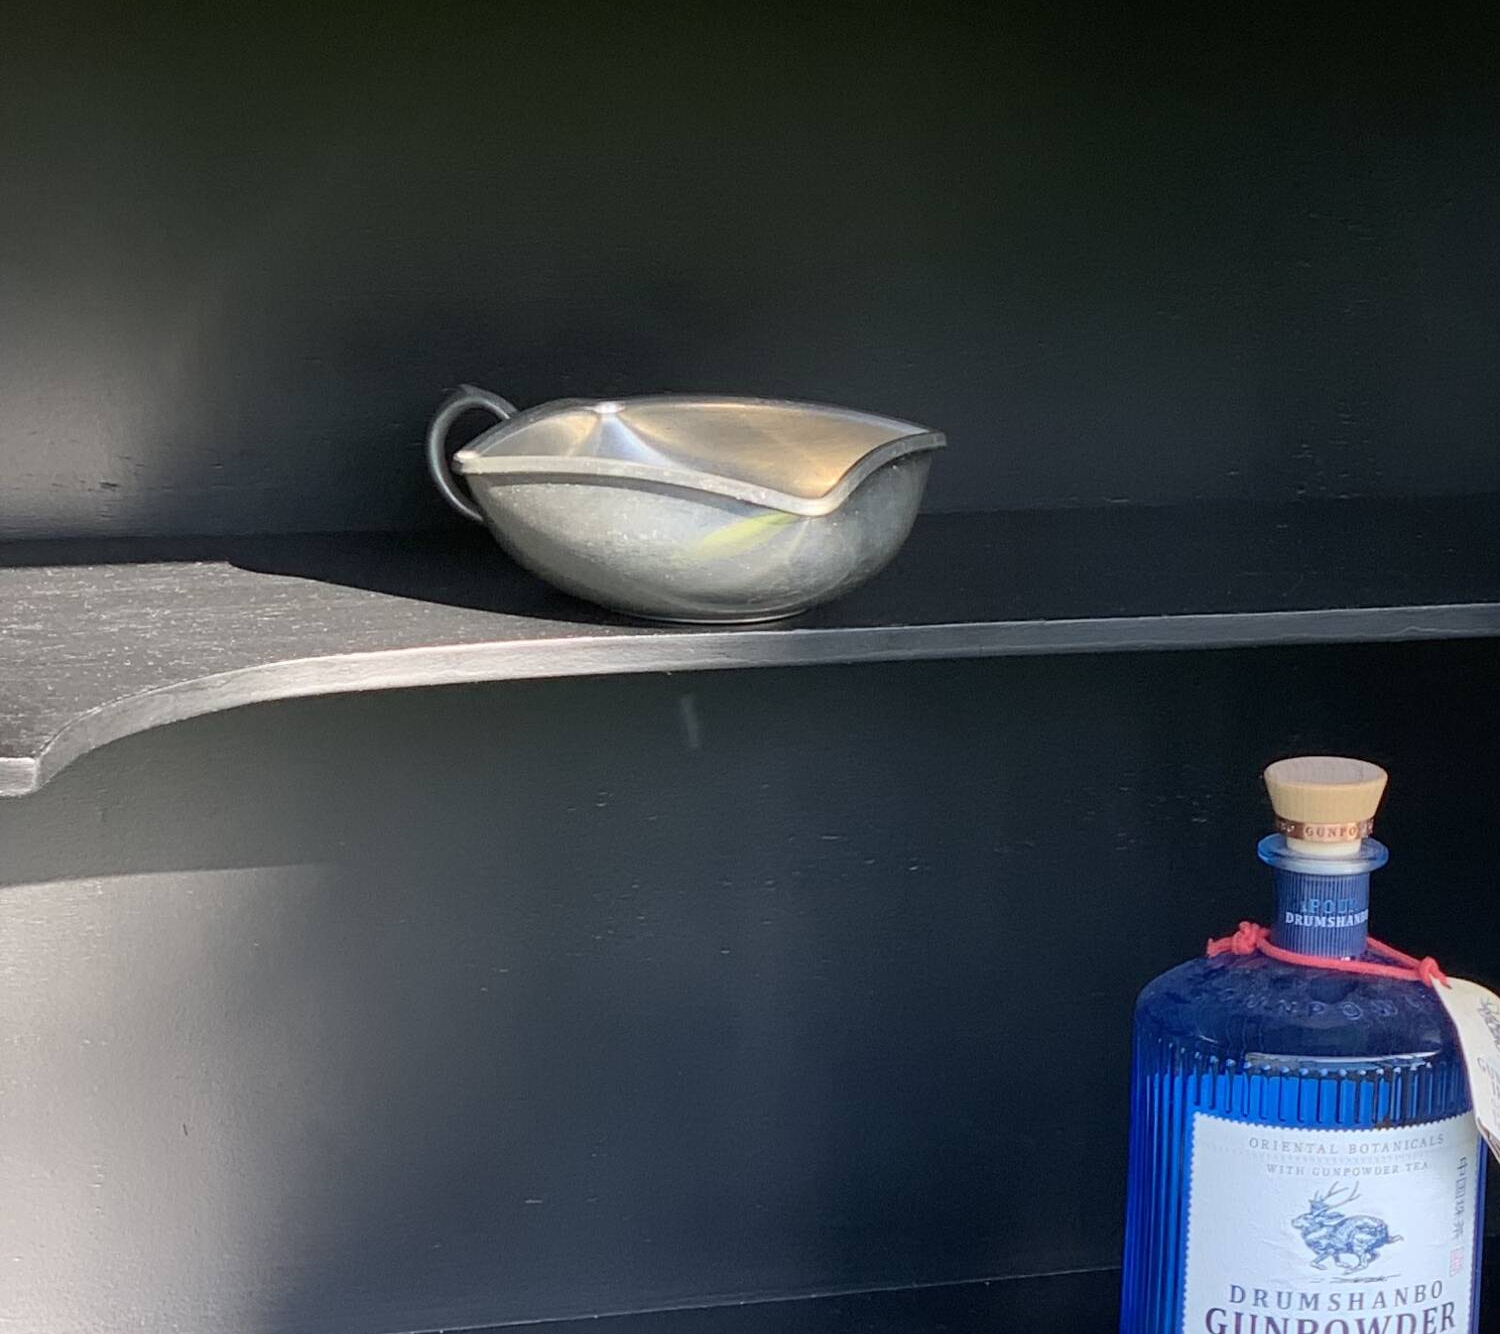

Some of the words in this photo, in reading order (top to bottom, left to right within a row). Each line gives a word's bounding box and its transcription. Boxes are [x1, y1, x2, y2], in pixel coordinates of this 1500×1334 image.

[1249, 1137, 1338, 1154] ORIENTAL
[1349, 1134, 1444, 1154] BOTANICALS
[1267, 1163, 1304, 1176] WITH
[1312, 1164, 1399, 1177] GUNPOWDER
[1406, 1161, 1428, 1172] TEA
[1229, 1280, 1443, 1312] DRUMSHANBO
